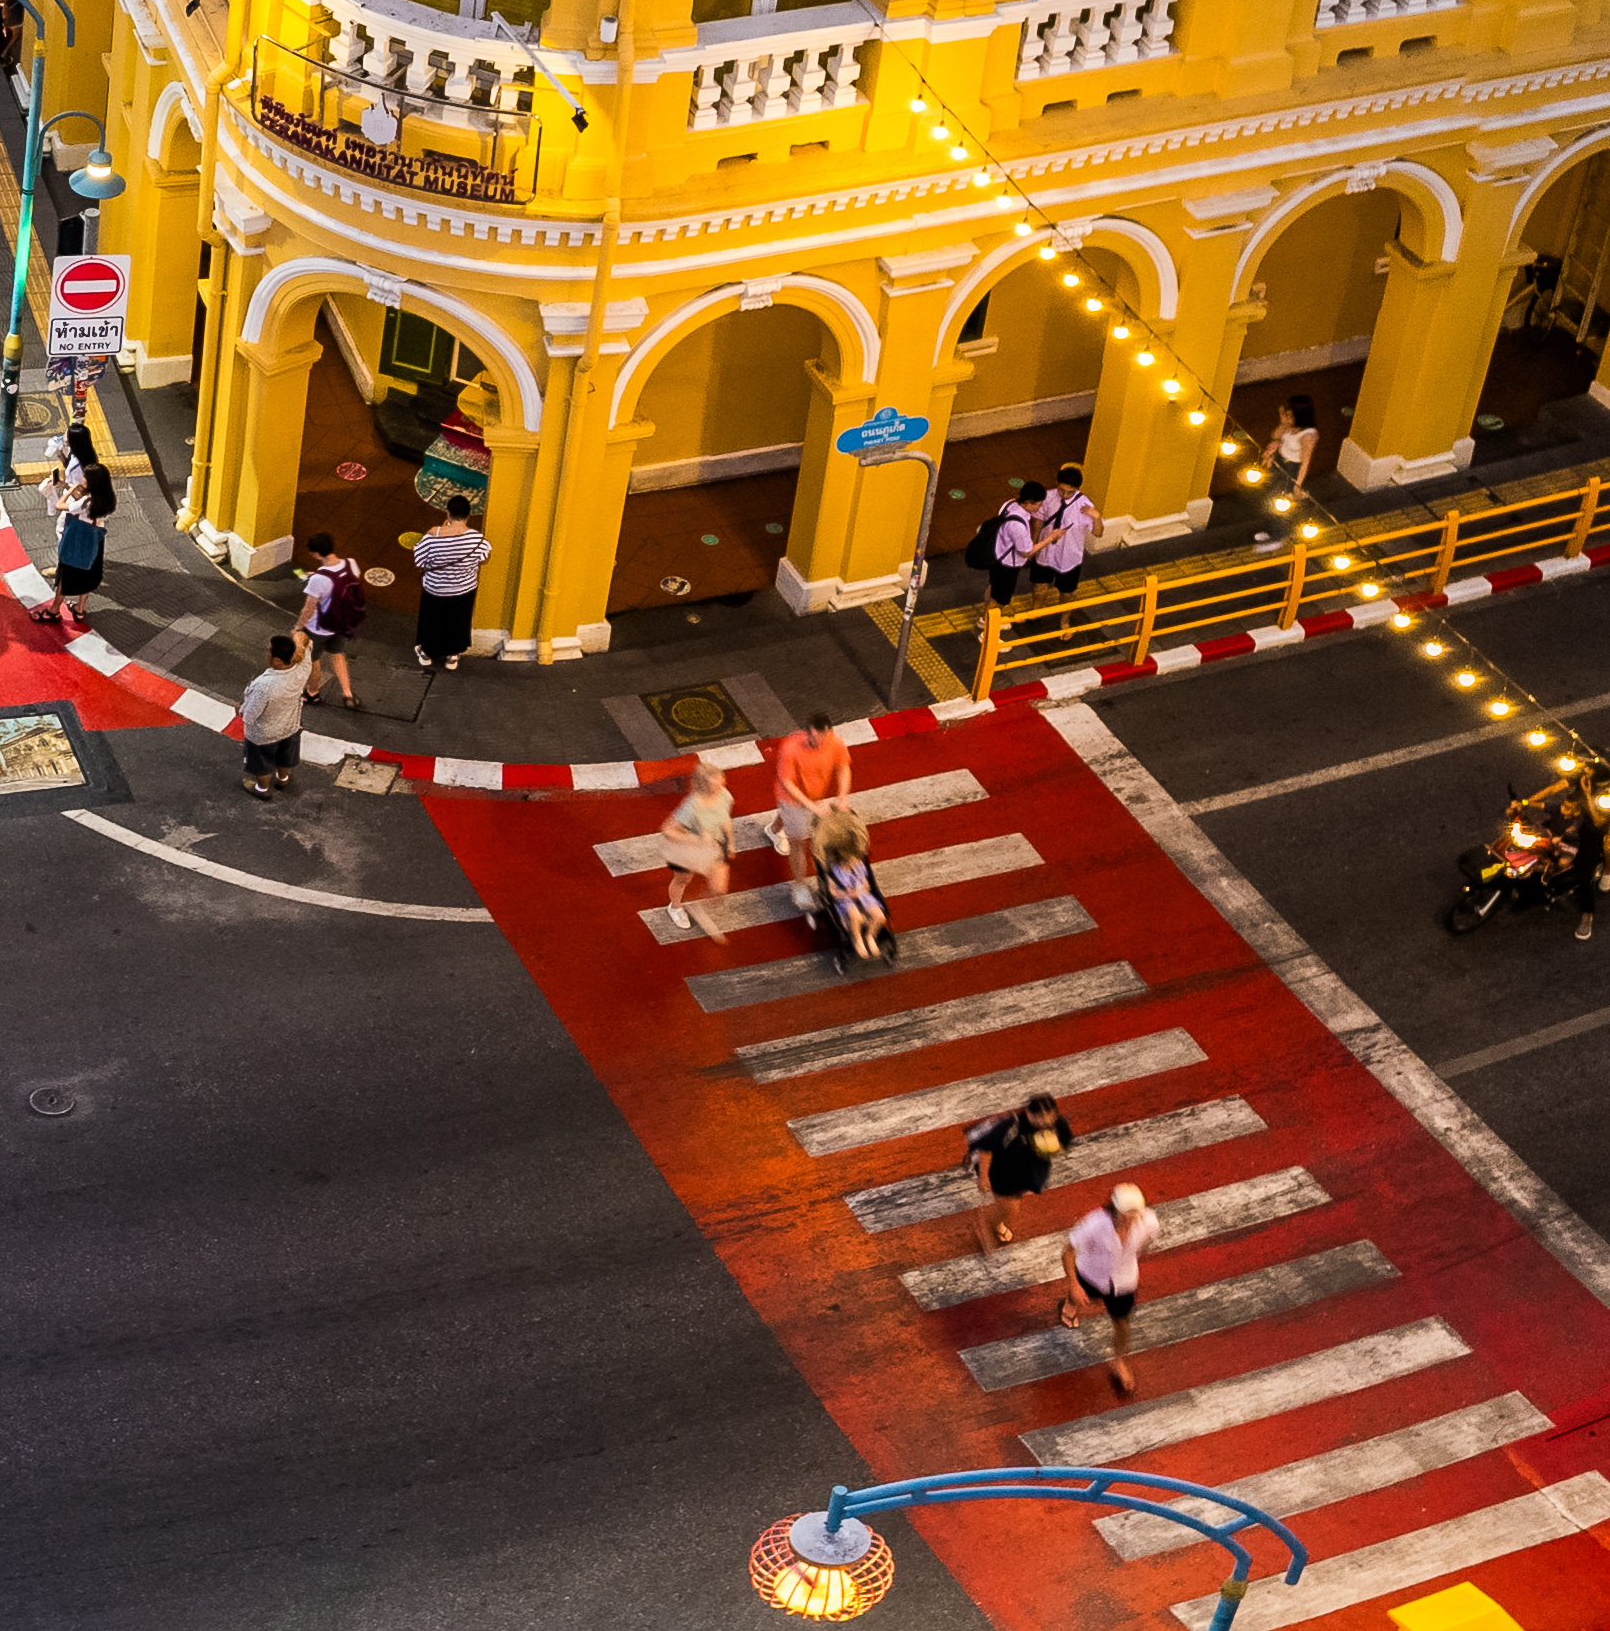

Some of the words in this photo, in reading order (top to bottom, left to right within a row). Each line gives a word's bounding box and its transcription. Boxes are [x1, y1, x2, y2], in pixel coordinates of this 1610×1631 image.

[260, 111, 419, 185] PERANAKANNITAT
[423, 173, 516, 202] MUSEUM
[55, 320, 119, 339] ห้ามเข้า
[59, 342, 74, 351] NO
[78, 342, 111, 351] ENTRY
